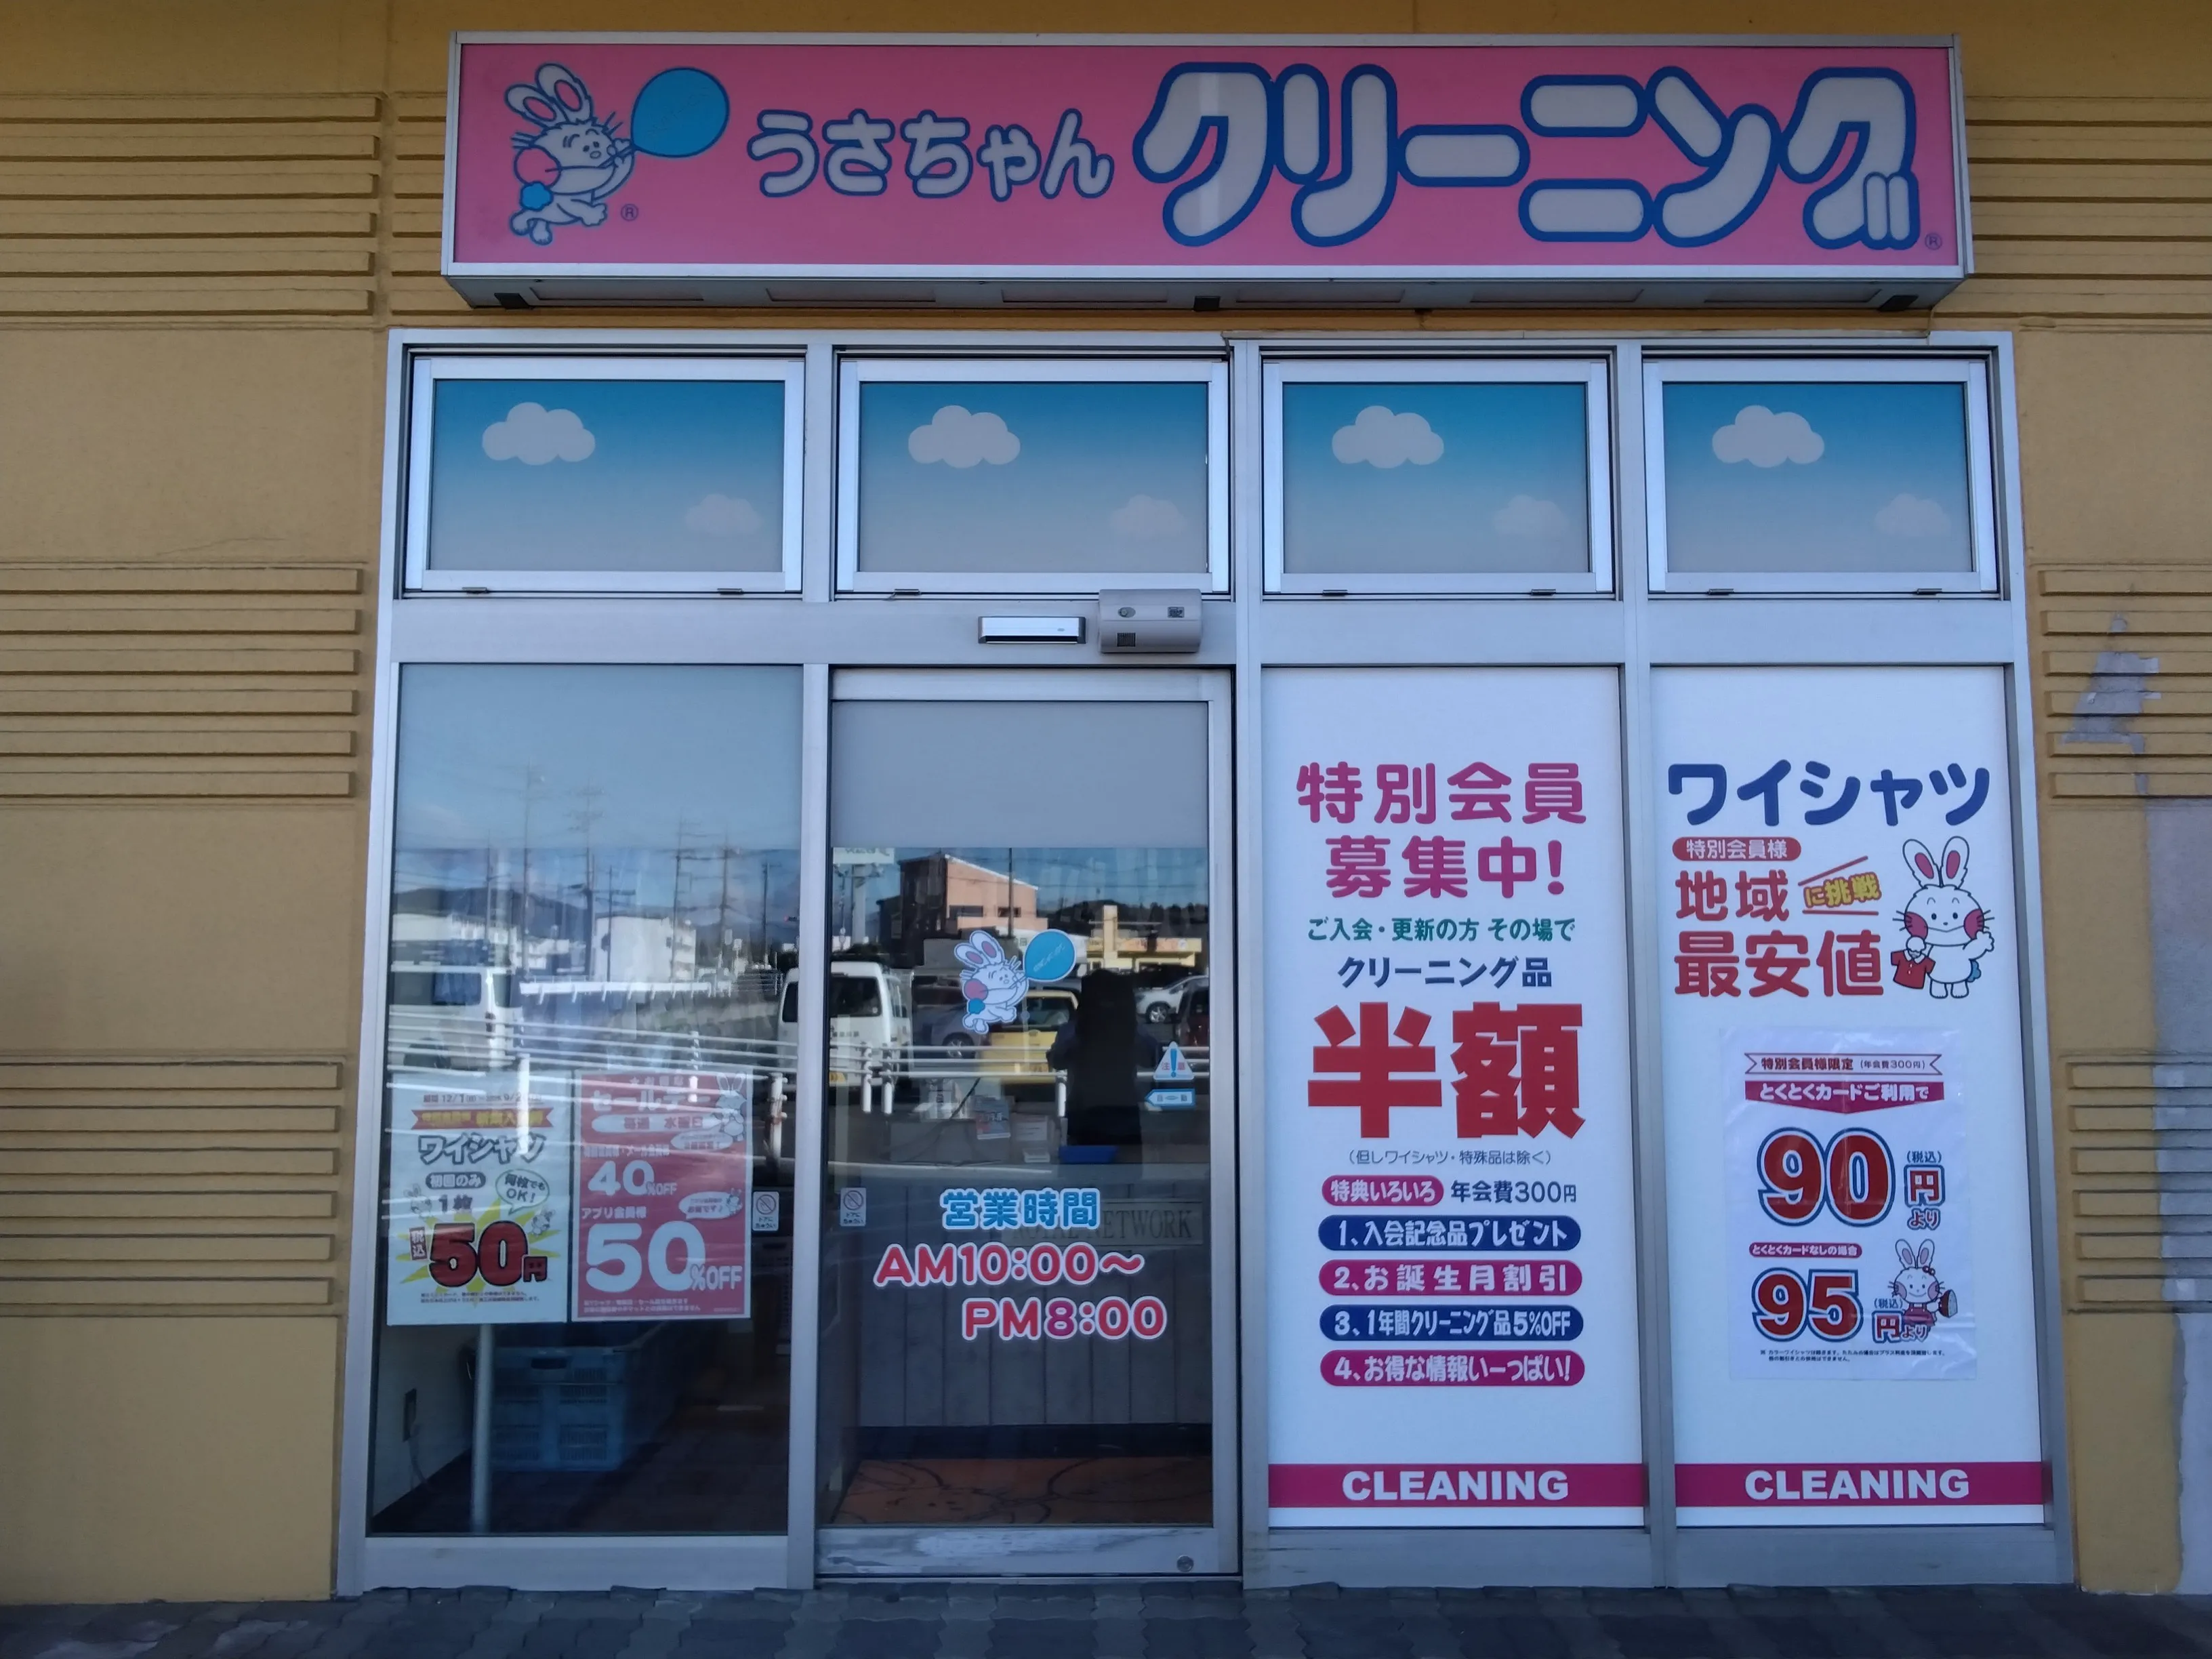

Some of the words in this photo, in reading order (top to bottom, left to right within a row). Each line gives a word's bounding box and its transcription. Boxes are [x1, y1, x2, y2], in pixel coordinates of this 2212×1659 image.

[748, 108, 1114, 202] うさちゃん
[1132, 62, 1920, 249] クリーニング
[1296, 761, 1586, 824] 特別会員
[1668, 758, 1990, 827] ワイシャツ
[1685, 839, 1788, 859] 特別会員様
[1325, 835, 1565, 899] 募集中!
[1675, 869, 1790, 922] 地域
[1803, 872, 1883, 908] に挑戦
[1308, 916, 1480, 942] ご入会・更新の方
[1488, 917, 1576, 942] その場で
[1337, 956, 1553, 989] クリーニング品
[1674, 929, 1884, 998] 最安値
[1307, 1001, 1586, 1139] 半額
[1761, 1057, 1854, 1071] 特別会員様限定
[1759, 1083, 1929, 1102] とくとくカードご利用で
[1348, 1149, 1551, 1166] (但しワイシャツ・特殊品は除く)
[1906, 1150, 1942, 1164] (税込)
[430, 1173, 482, 1188] 初回のみ
[1330, 1179, 1436, 1202] 特典いろいろ
[1450, 1180, 1577, 1203] 年会費300円
[940, 1188, 1100, 1230] 営業時間
[1094, 1210, 1193, 1240] ETWORK
[1906, 1208, 1941, 1231] より
[1752, 1244, 1858, 1256] とくとくカードなしの場合
[962, 1295, 1168, 1341] PM8:00
[1341, 1469, 1570, 1502] CLEANING
[1744, 1468, 1970, 1500] CLEANING
